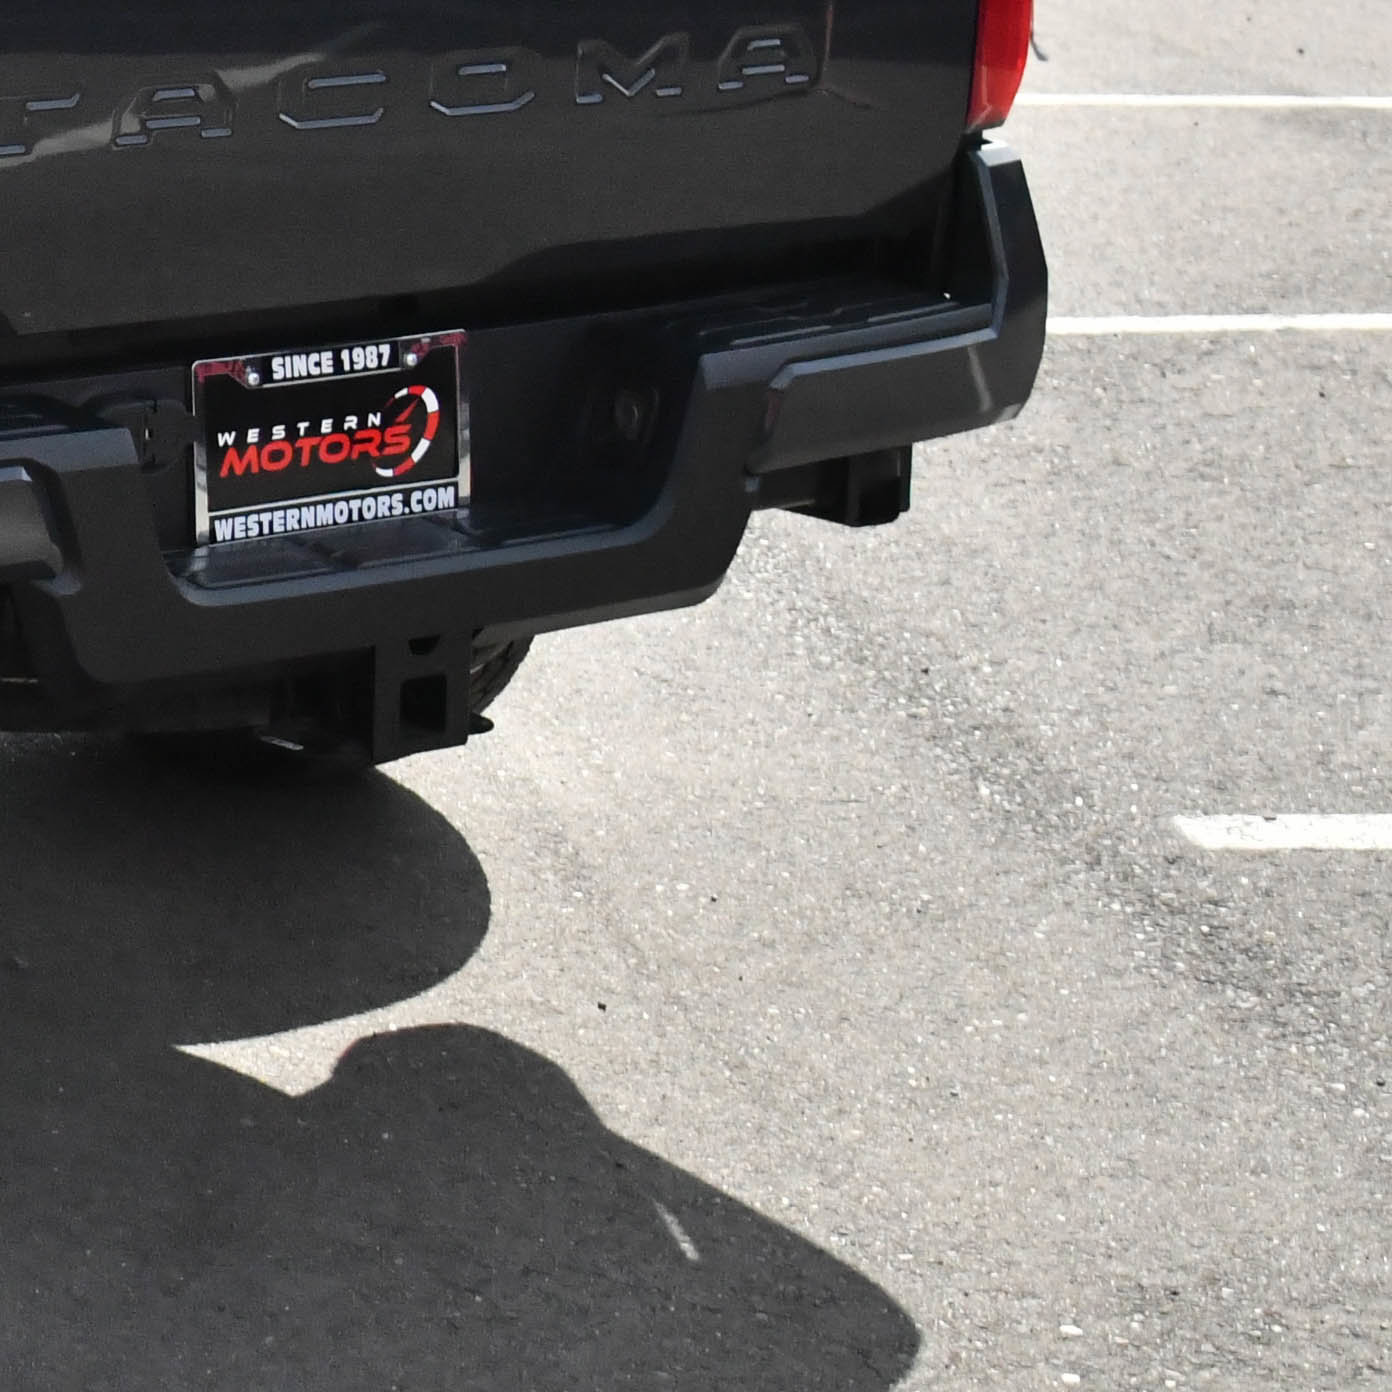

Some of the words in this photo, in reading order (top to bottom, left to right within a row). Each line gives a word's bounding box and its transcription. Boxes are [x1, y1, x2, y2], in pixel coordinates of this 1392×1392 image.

[271, 352, 334, 381] SINCE
[340, 343, 392, 372] 1987
[217, 412, 382, 448] WESTERN
[219, 423, 412, 478] MOTORS
[214, 486, 455, 542] WESTERNMOTORS.COM
